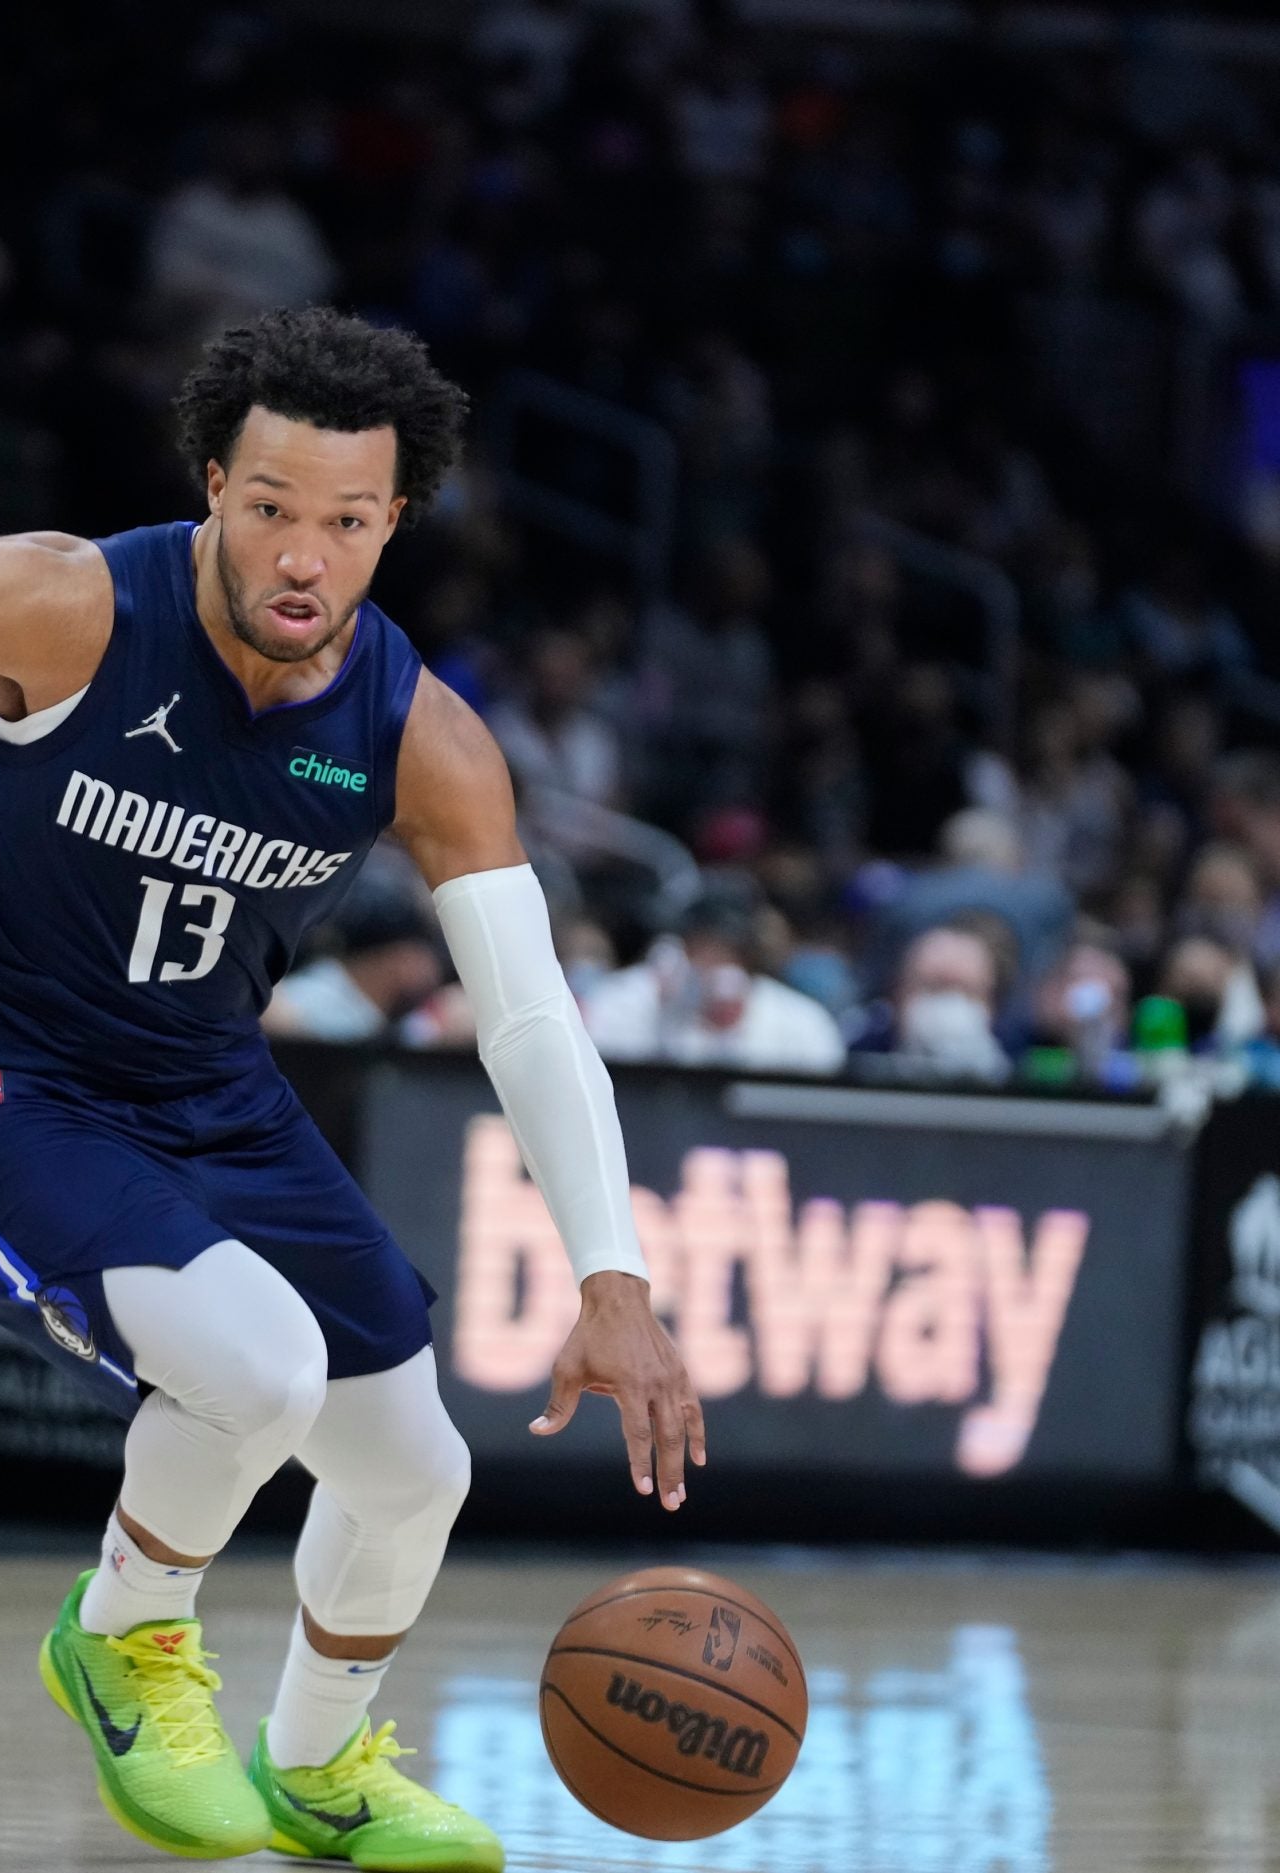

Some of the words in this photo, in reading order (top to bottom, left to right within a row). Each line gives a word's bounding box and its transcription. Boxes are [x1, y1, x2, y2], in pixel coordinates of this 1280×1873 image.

[289, 754, 368, 792] chime
[56, 770, 352, 889] MAVERICKS
[128, 875, 236, 983] 13
[606, 1671, 769, 1778] Wilson
